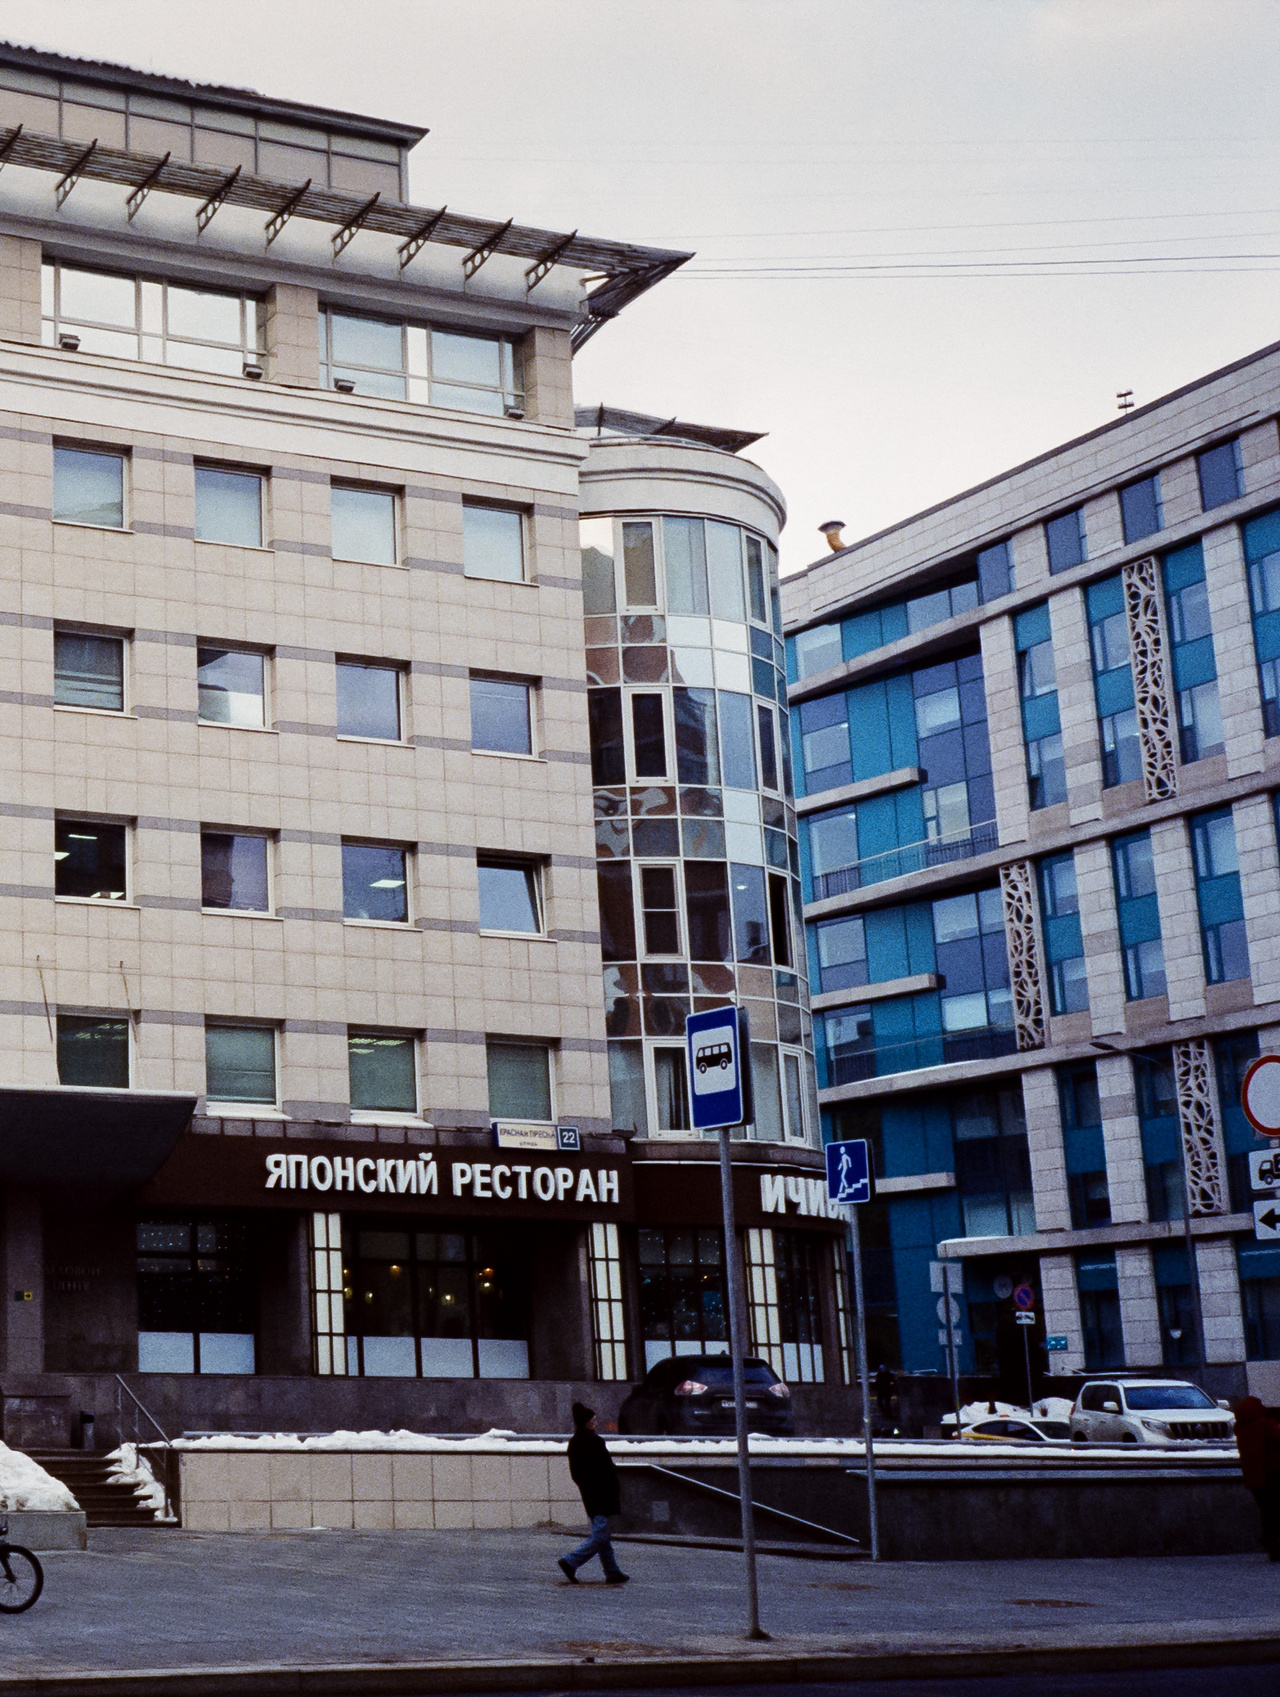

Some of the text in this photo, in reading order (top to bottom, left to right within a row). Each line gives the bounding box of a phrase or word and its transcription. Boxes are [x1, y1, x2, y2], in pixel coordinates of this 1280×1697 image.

[562, 1131, 575, 1143] 22
[265, 1152, 620, 1205] ЯПОНСКИЙ РЕСТОРАН
